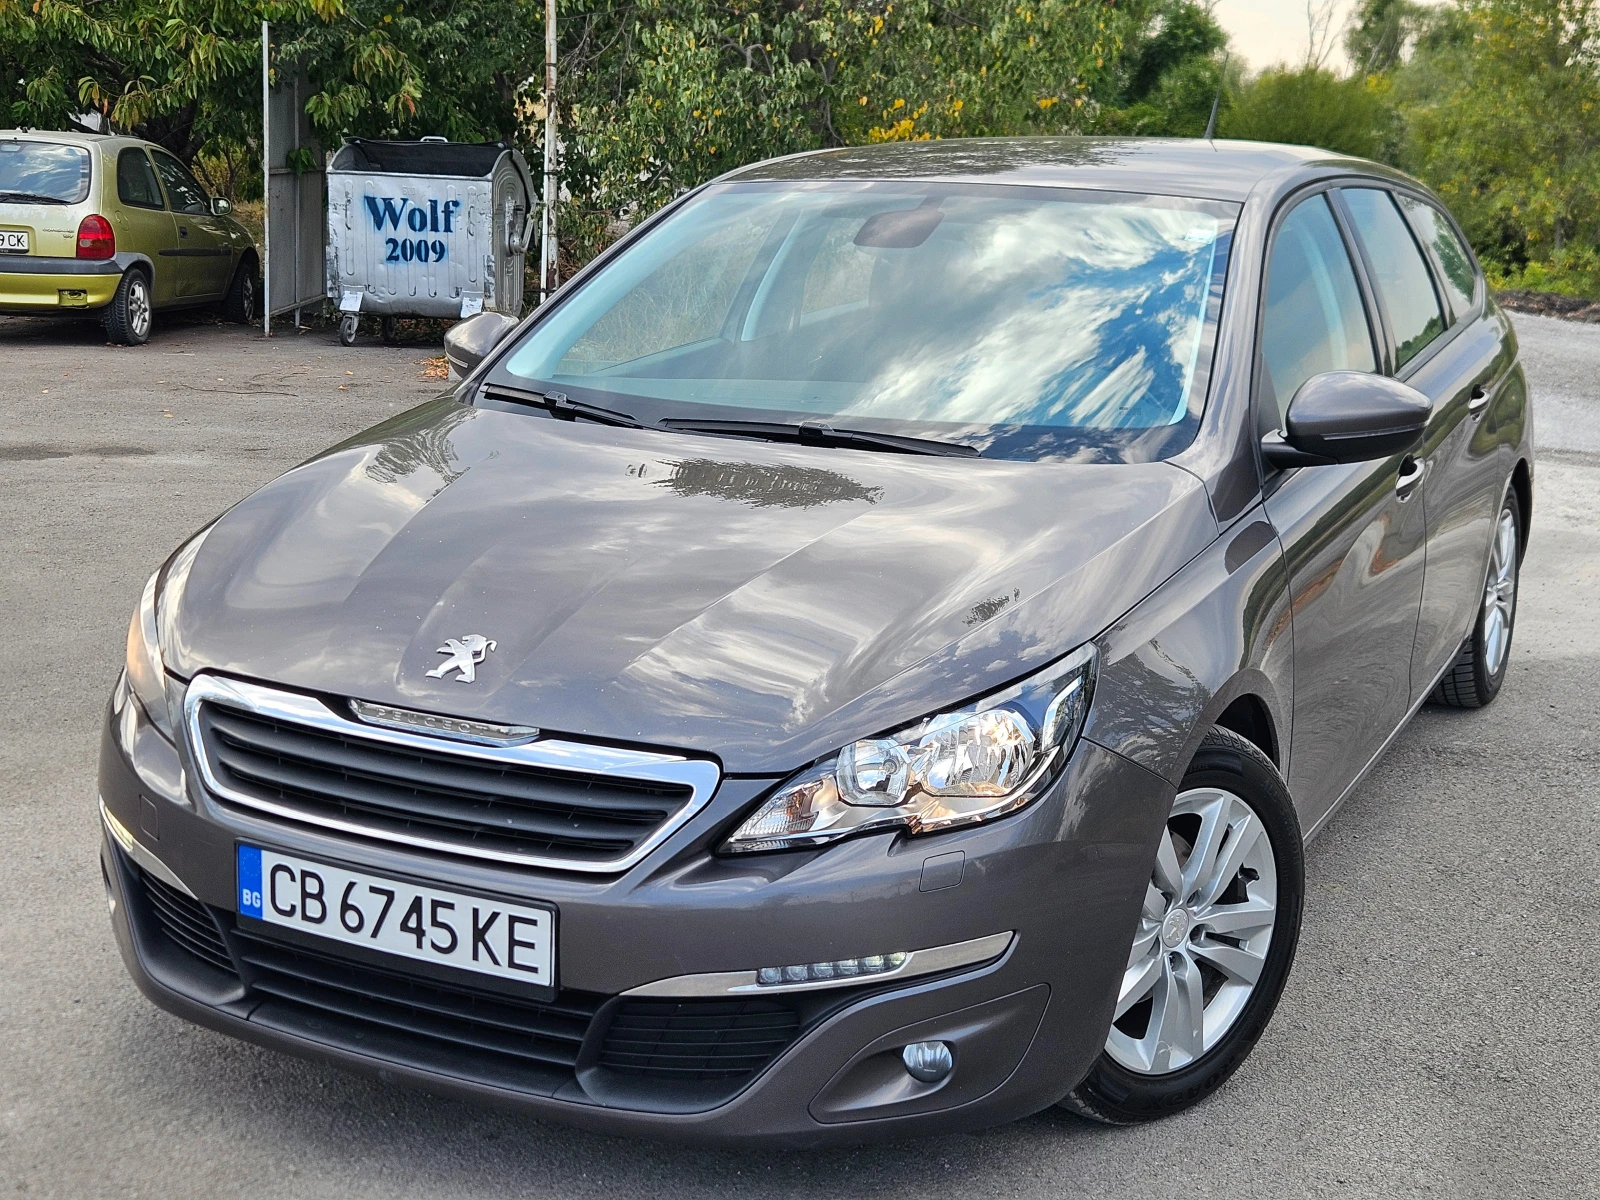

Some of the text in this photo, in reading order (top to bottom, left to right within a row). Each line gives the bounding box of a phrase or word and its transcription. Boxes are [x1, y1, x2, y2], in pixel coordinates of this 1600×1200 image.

[364, 195, 460, 233] Wolf
[386, 238, 446, 263] 2009
[376, 707, 490, 736] PEUGEOT
[242, 888, 261, 908] BG
[270, 863, 540, 974] CB 6745 KE
